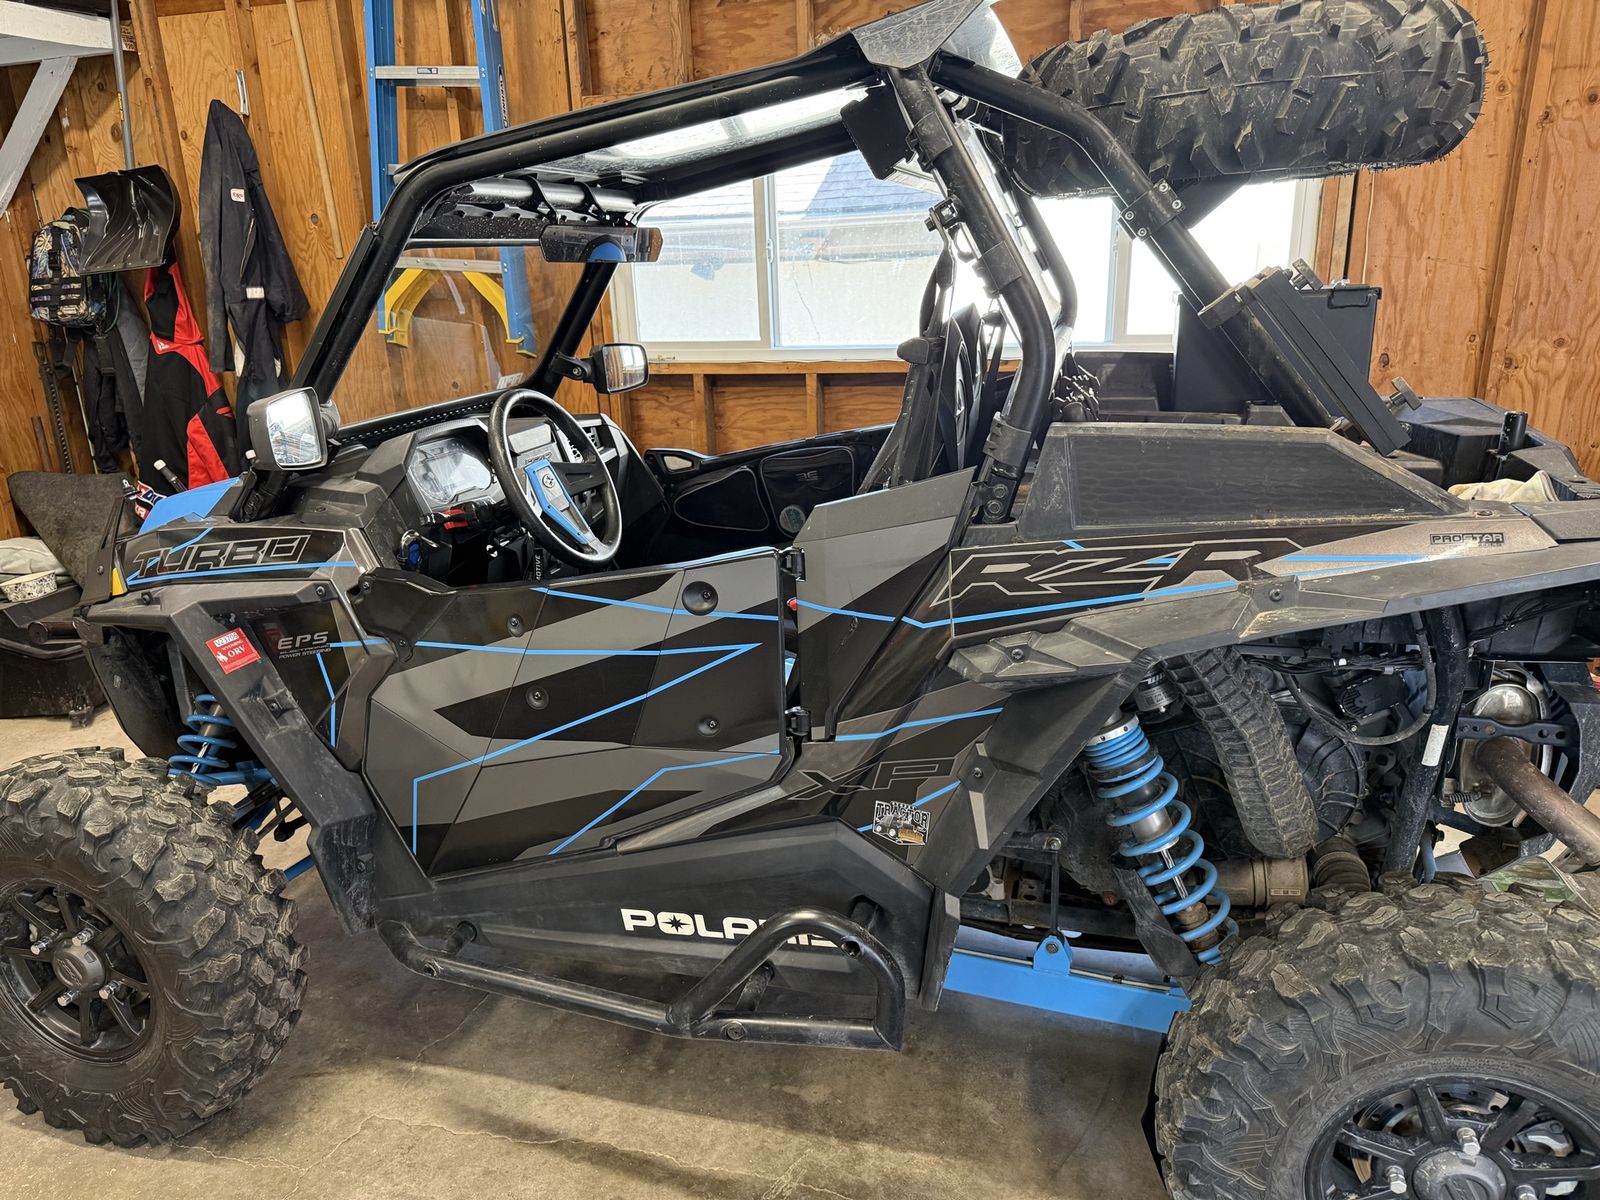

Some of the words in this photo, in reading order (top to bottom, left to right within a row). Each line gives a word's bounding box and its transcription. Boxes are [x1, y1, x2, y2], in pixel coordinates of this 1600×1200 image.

[1430, 533, 1504, 544] PROSTAR
[133, 535, 311, 578] TURBO
[930, 537, 1303, 607] RZR
[227, 644, 246, 658] ORV
[277, 631, 329, 650] EPS
[787, 757, 957, 801] XP
[876, 801, 929, 830] TRACTOR
[620, 908, 839, 948] POLA
